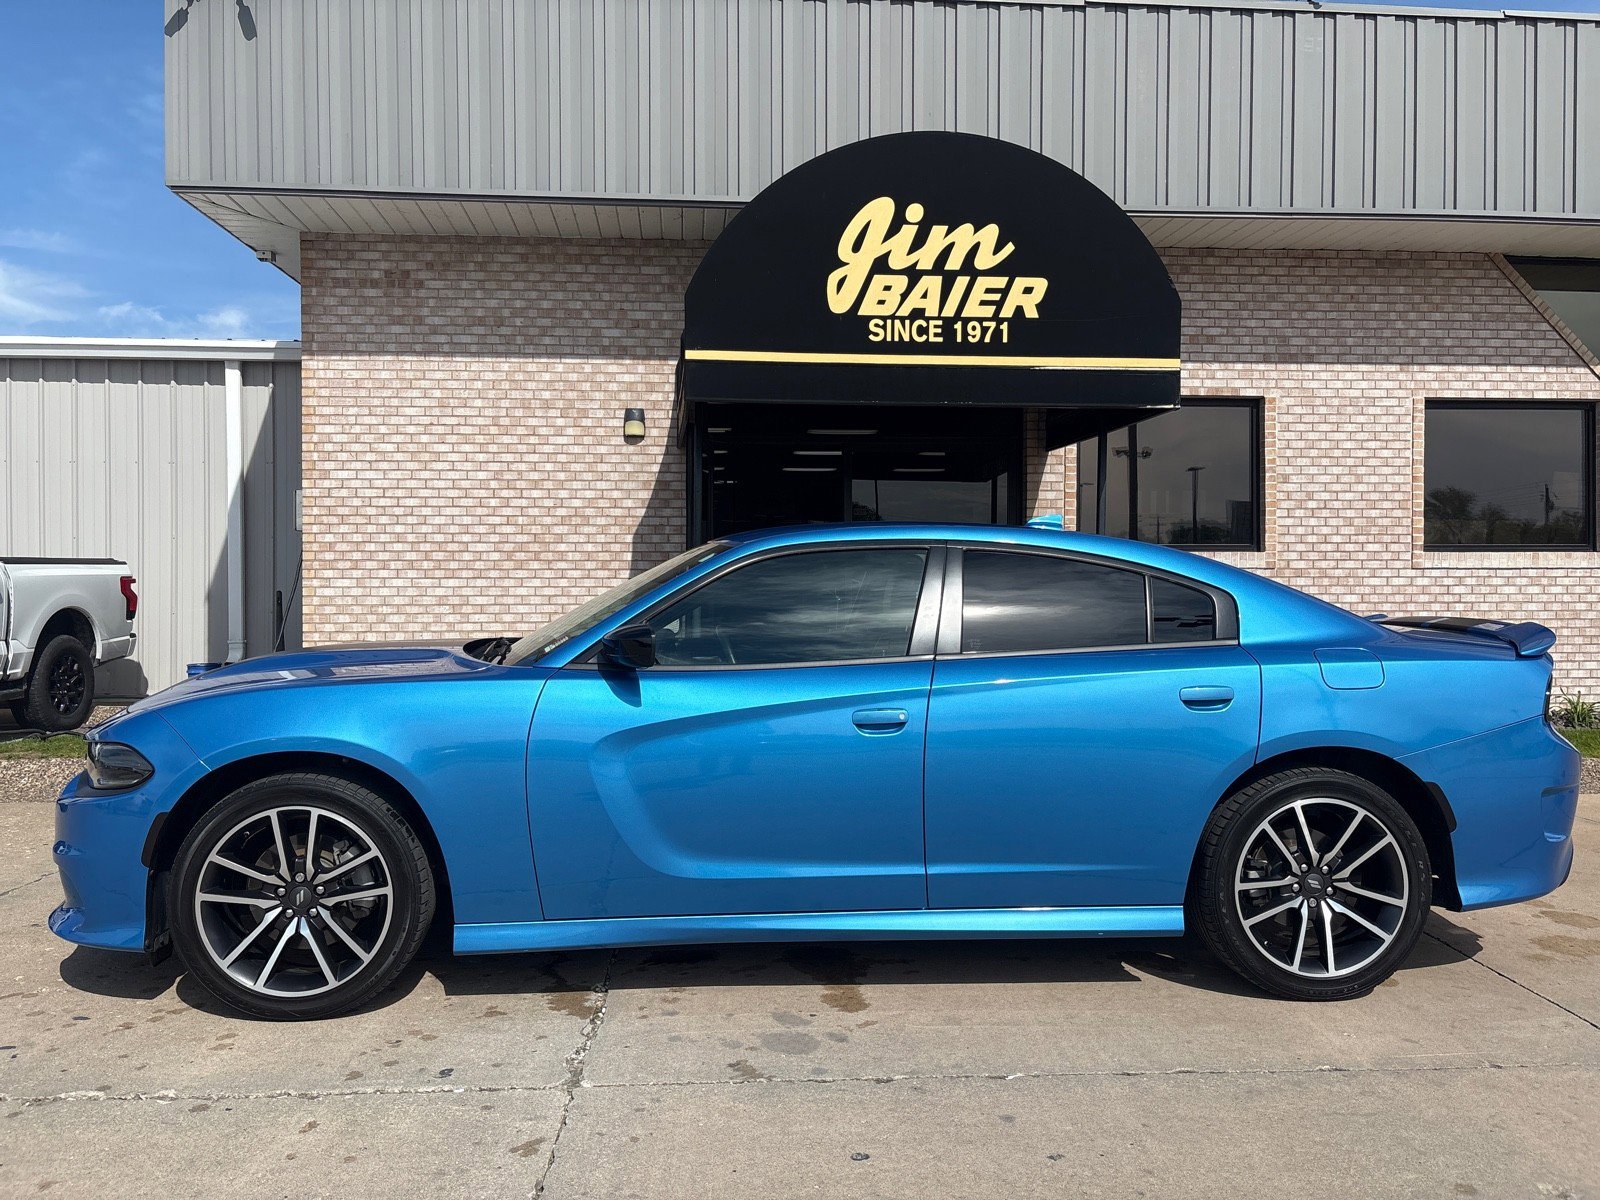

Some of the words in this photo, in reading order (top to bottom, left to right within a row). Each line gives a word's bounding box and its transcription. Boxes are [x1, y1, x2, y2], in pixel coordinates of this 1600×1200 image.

[827, 196, 1016, 314] Jim
[857, 274, 1049, 319] BAIER
[868, 318, 944, 343] SINCE
[953, 320, 1008, 343] 1971
